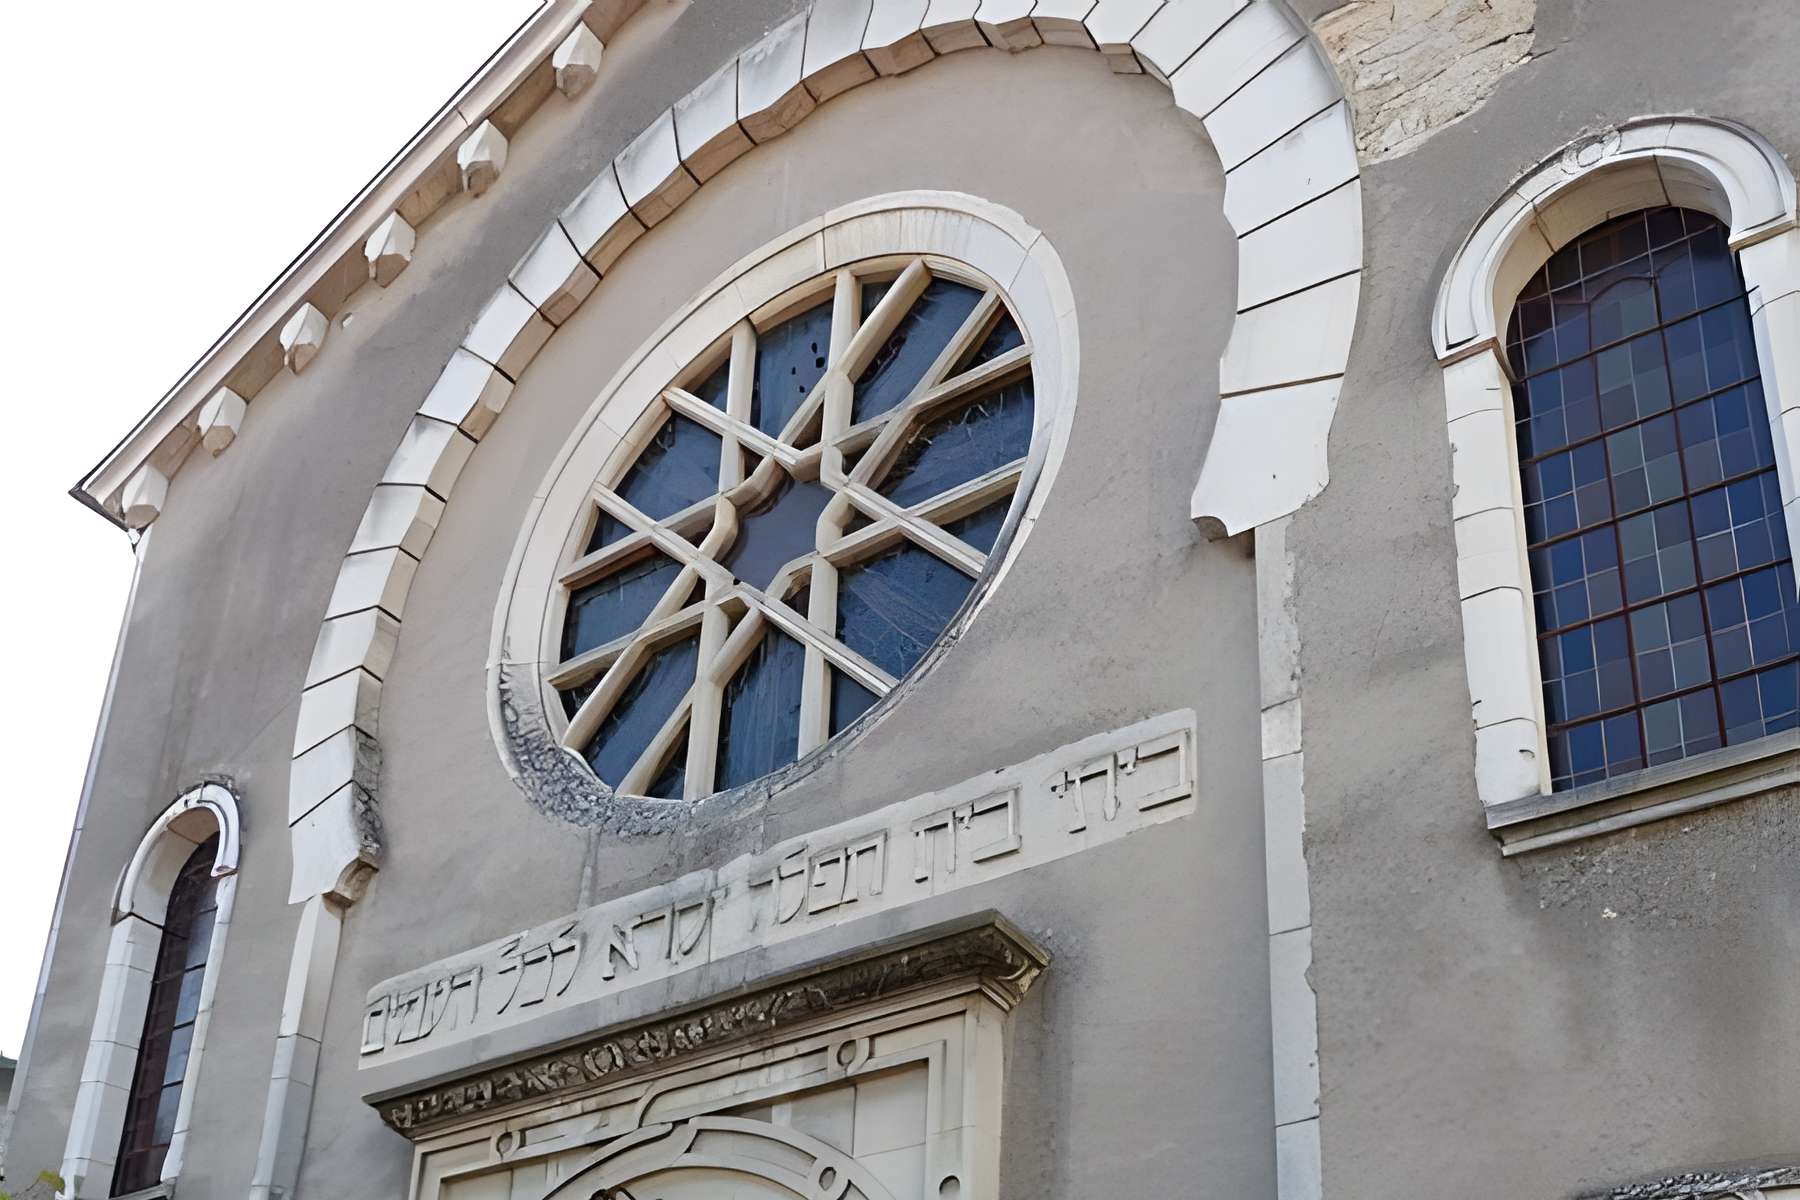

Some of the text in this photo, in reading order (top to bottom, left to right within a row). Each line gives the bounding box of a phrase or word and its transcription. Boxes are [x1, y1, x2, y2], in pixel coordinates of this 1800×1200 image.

[1041, 727, 1193, 835] ביתי
[748, 827, 888, 931] תפלה
[911, 784, 1022, 890] בית
[497, 920, 584, 1015] לכל
[601, 884, 729, 981] יקרא
